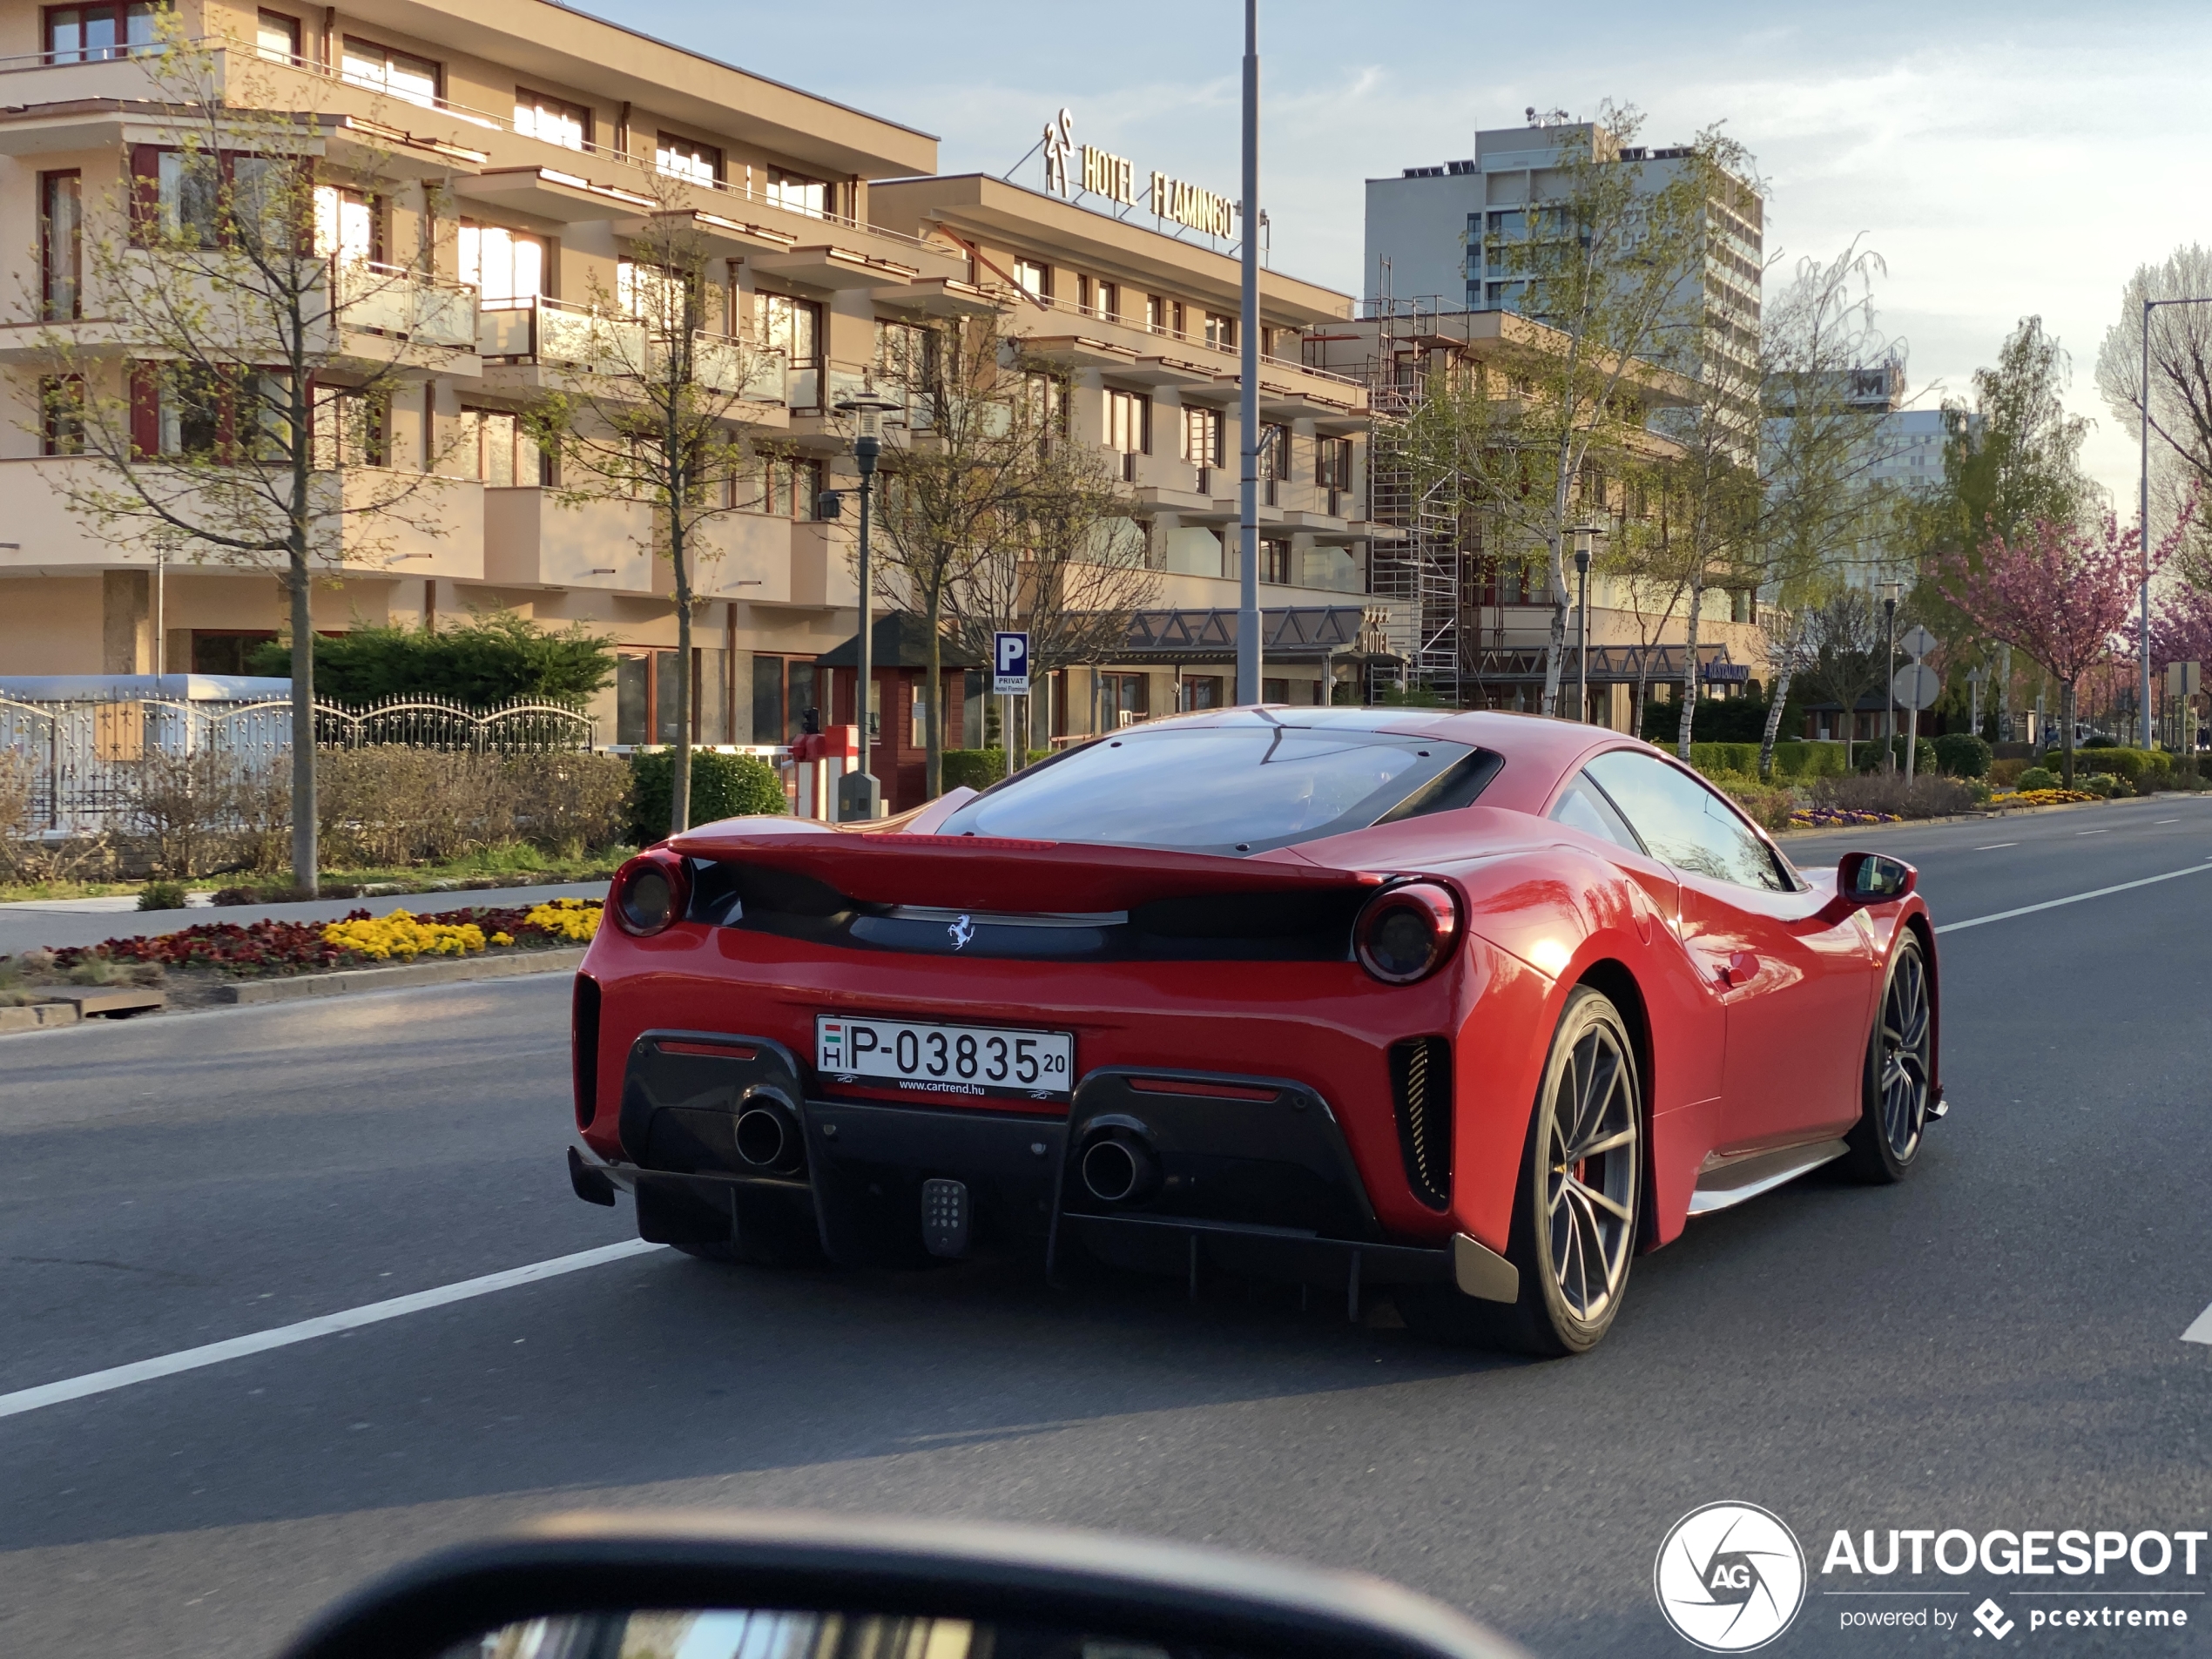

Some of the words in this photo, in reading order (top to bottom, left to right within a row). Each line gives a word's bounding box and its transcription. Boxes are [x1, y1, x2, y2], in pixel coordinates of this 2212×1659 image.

[1082, 144, 1138, 206] HOTEL
[1150, 171, 1234, 239] FLAMINGO
[1000, 637, 1024, 671] P
[1362, 631, 1391, 654] HOTEL
[824, 1046, 840, 1068] H
[851, 1026, 1039, 1083] P-03835
[1043, 1053, 1065, 1073] 20
[899, 1081, 985, 1096] www.cartrend.hu
